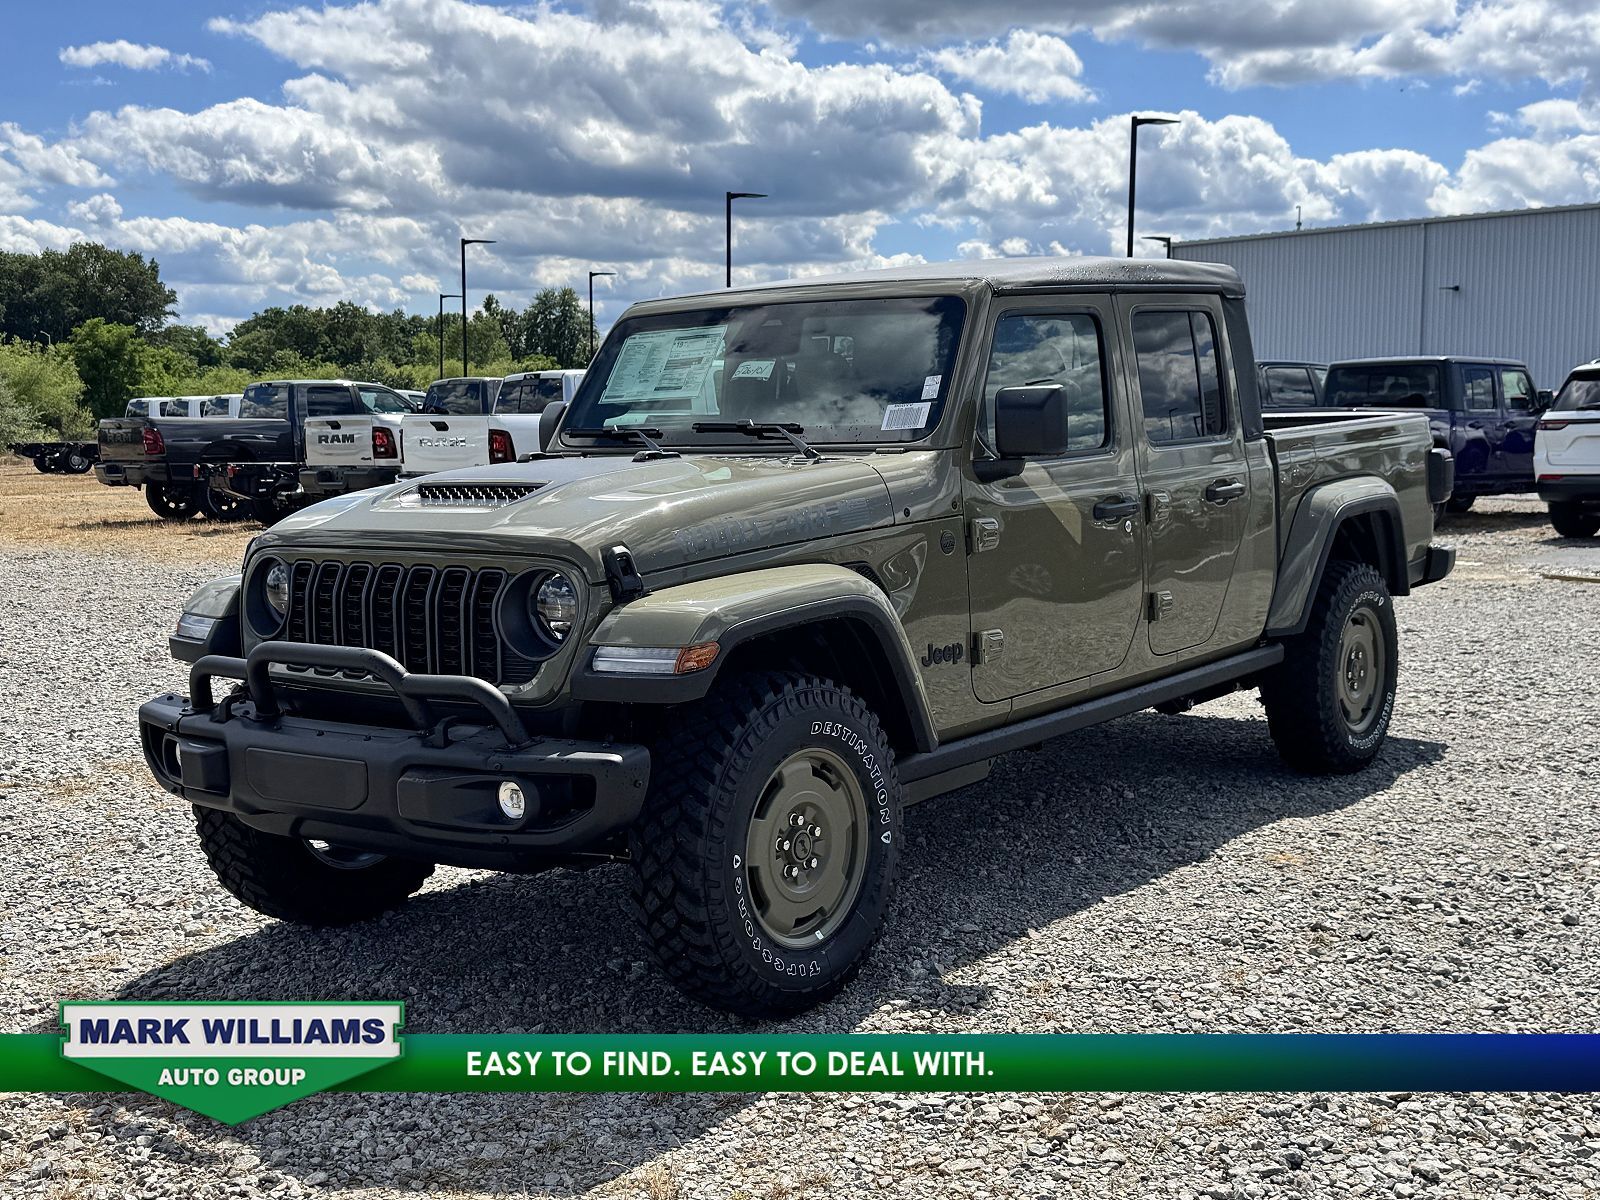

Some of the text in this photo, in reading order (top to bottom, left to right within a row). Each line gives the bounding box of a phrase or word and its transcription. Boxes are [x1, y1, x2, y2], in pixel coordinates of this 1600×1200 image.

[317, 434, 355, 444] RAM
[921, 642, 964, 667] Jeep
[810, 720, 892, 825] DESTINATION
